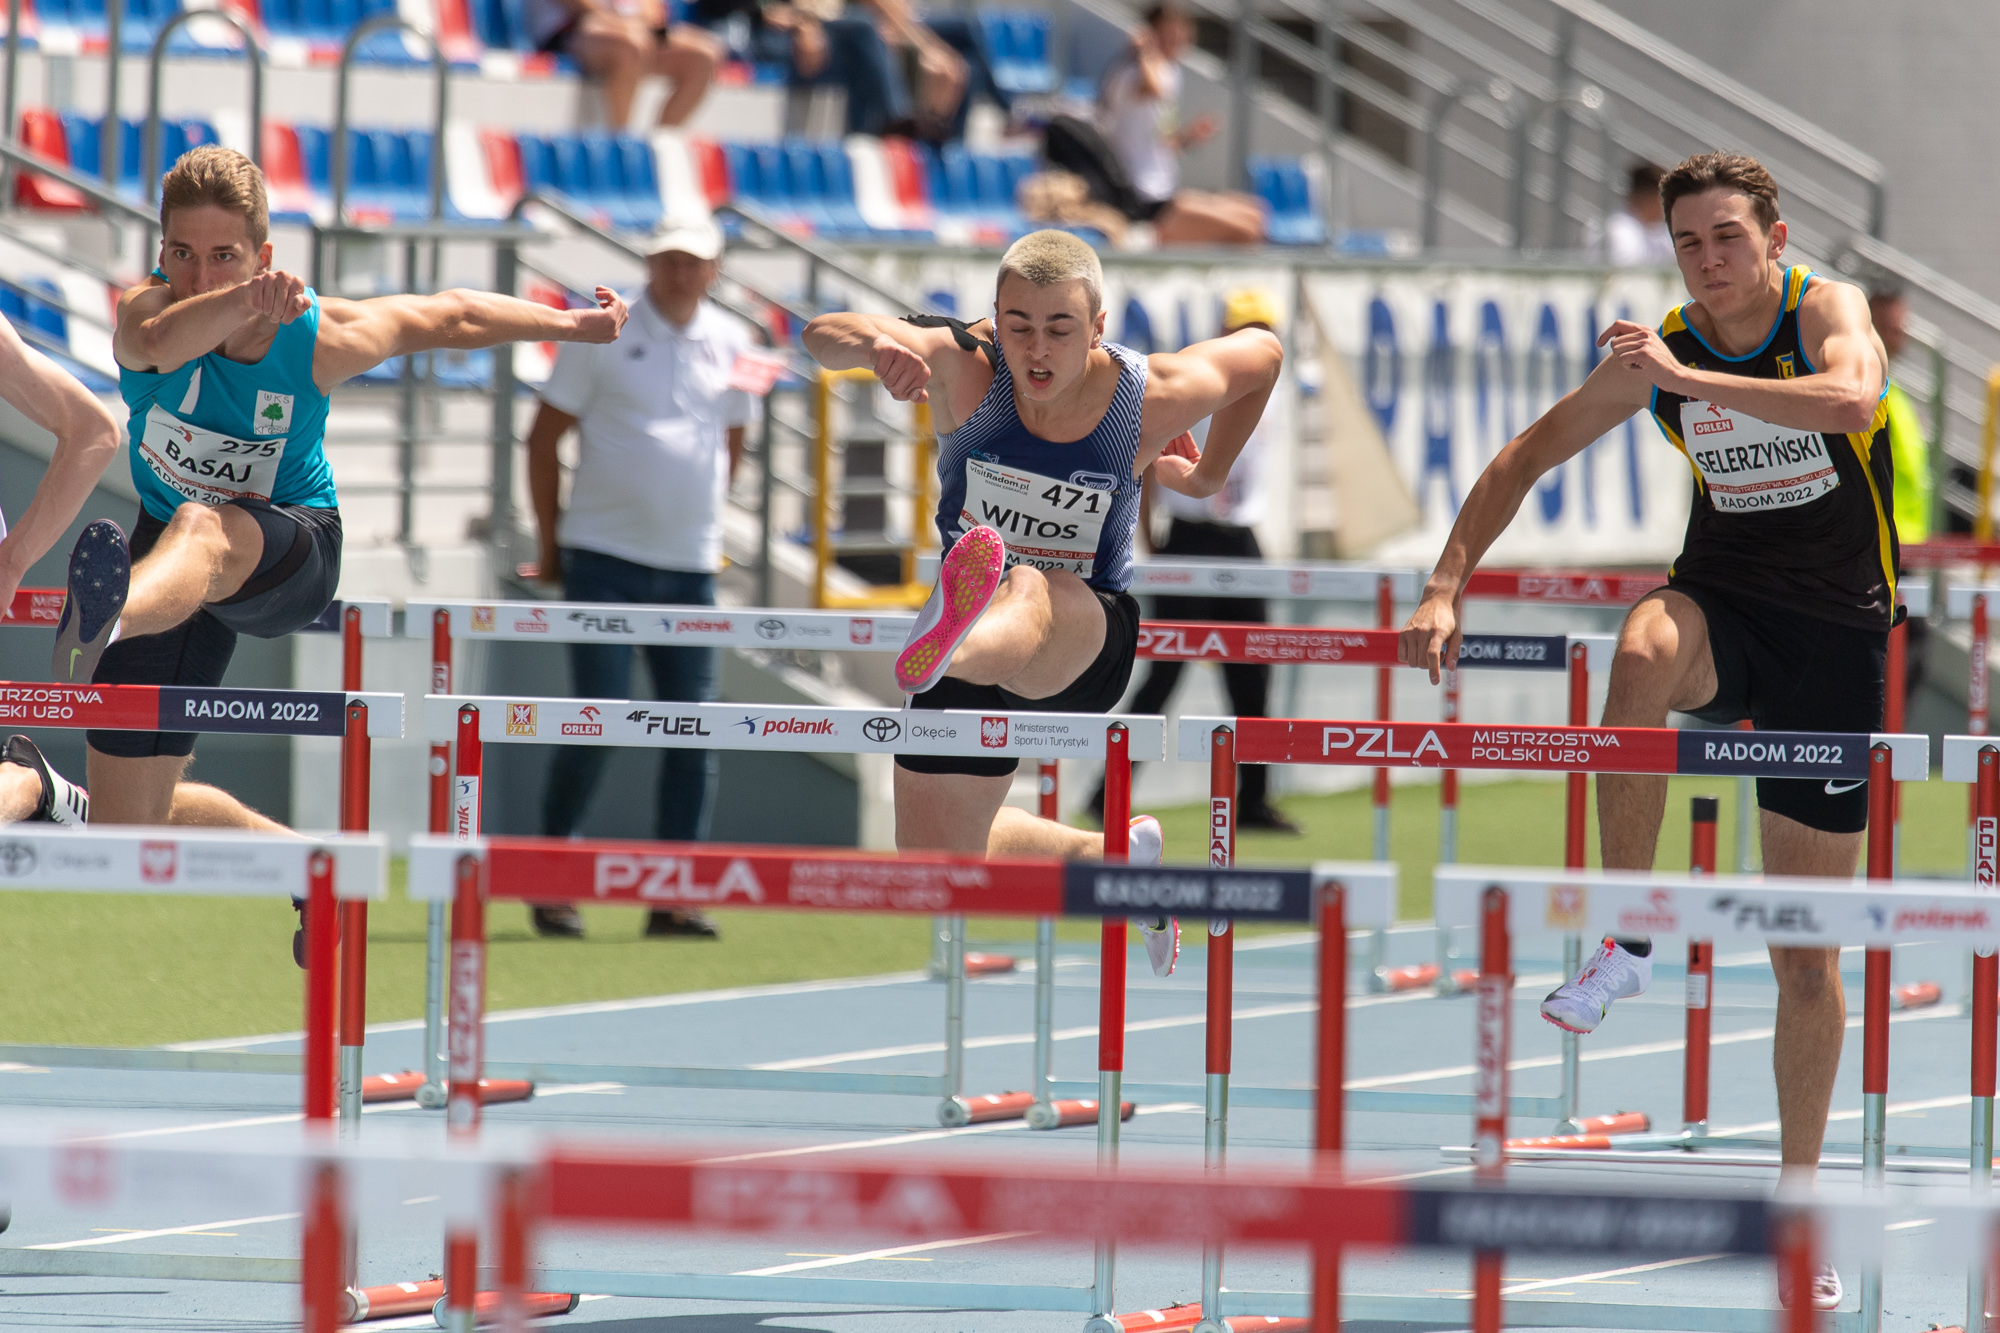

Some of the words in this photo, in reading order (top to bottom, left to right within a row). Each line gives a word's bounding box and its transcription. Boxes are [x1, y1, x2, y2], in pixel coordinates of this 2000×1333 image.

[264, 392, 290, 404] UKS
[1695, 421, 1731, 434] ORLEN
[218, 440, 278, 457] 275
[1695, 433, 1823, 474] SELERZYŃSKI
[165, 438, 252, 483] BASAJ
[146, 457, 197, 498] RADOM
[202, 492, 230, 505] 202
[970, 465, 1030, 491] visitRadom.pl
[1729, 481, 1783, 494] MISTRZOSTWA
[1784, 475, 1814, 487] POLSKI
[1815, 468, 1833, 479] U20
[1041, 484, 1100, 514] 471
[1720, 494, 1775, 509] RADOM
[1777, 486, 1814, 504] 2022
[981, 499, 1080, 540] WITOS
[964, 512, 980, 527] PZL
[1004, 543, 1040, 555] ZOSTWA
[1041, 550, 1073, 558] POLSKI
[1074, 552, 1093, 560] U20
[582, 617, 635, 634] FUEL
[1137, 628, 1229, 657] PZLA
[1246, 631, 1368, 648] MISTRZOSTWA
[1459, 642, 1501, 660] DOM
[1503, 643, 1548, 661] 2022
[33, 706, 74, 719] U20
[185, 699, 265, 719] RADOM
[271, 702, 320, 721] 2022
[507, 724, 535, 735] PZLA
[563, 724, 600, 735] ORLEN
[647, 716, 711, 736] FUEL
[762, 717, 835, 737] polanik
[911, 725, 957, 740] Okęcie
[1014, 723, 1069, 734] Ministerstwo
[1014, 736, 1044, 747] Sportu
[1050, 737, 1089, 748] Turystyki
[1322, 727, 1448, 759] PZLA
[1472, 730, 1620, 747] MISTRZOSTWA
[1472, 747, 1542, 762] POLSKI
[1549, 749, 1590, 763] U20
[1705, 742, 1787, 762] RADOM
[1793, 744, 1843, 764] 2022
[595, 855, 764, 902] PZLA
